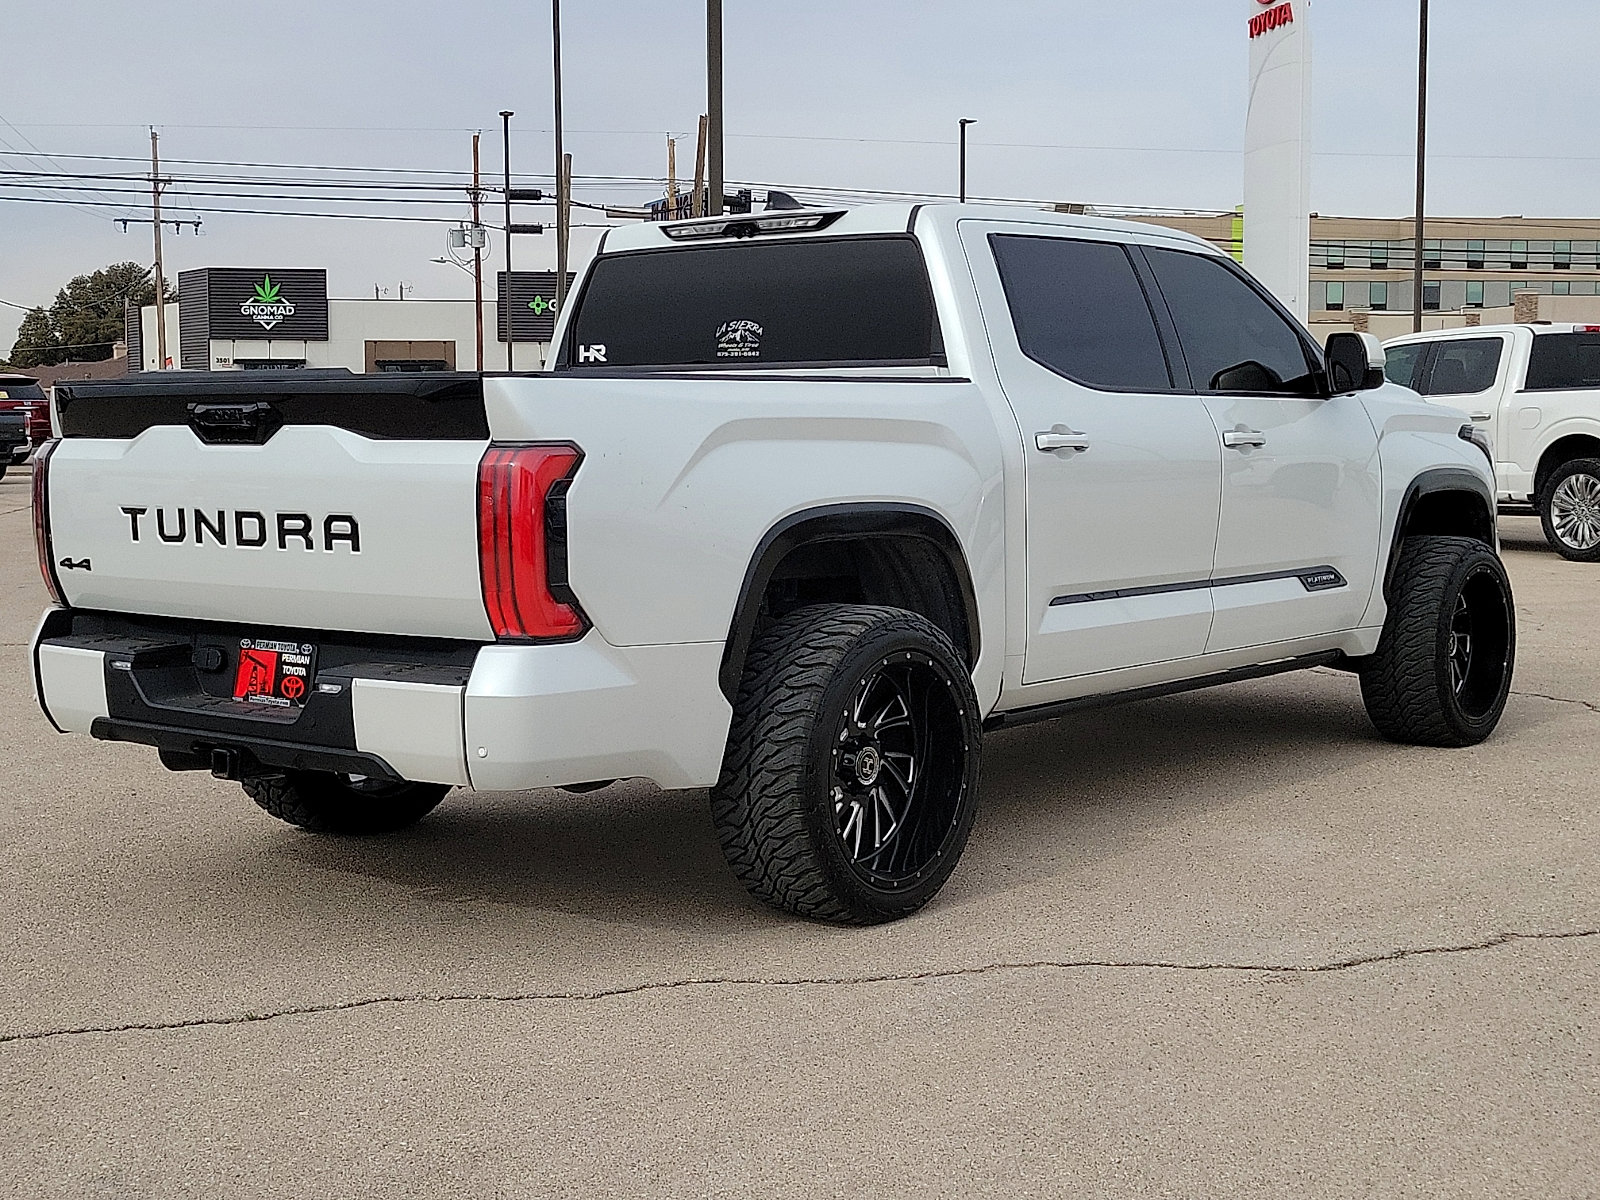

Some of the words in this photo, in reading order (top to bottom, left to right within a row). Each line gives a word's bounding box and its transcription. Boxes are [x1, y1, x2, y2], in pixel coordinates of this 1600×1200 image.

[1247, 2, 1294, 39] TOYOTA
[241, 305, 295, 315] GNOMAD
[715, 322, 727, 338] LA
[727, 320, 763, 336] SIERRA
[119, 505, 361, 553] TUNDRA
[282, 653, 310, 664] PERMIAN
[282, 665, 306, 676] TOYOTA
